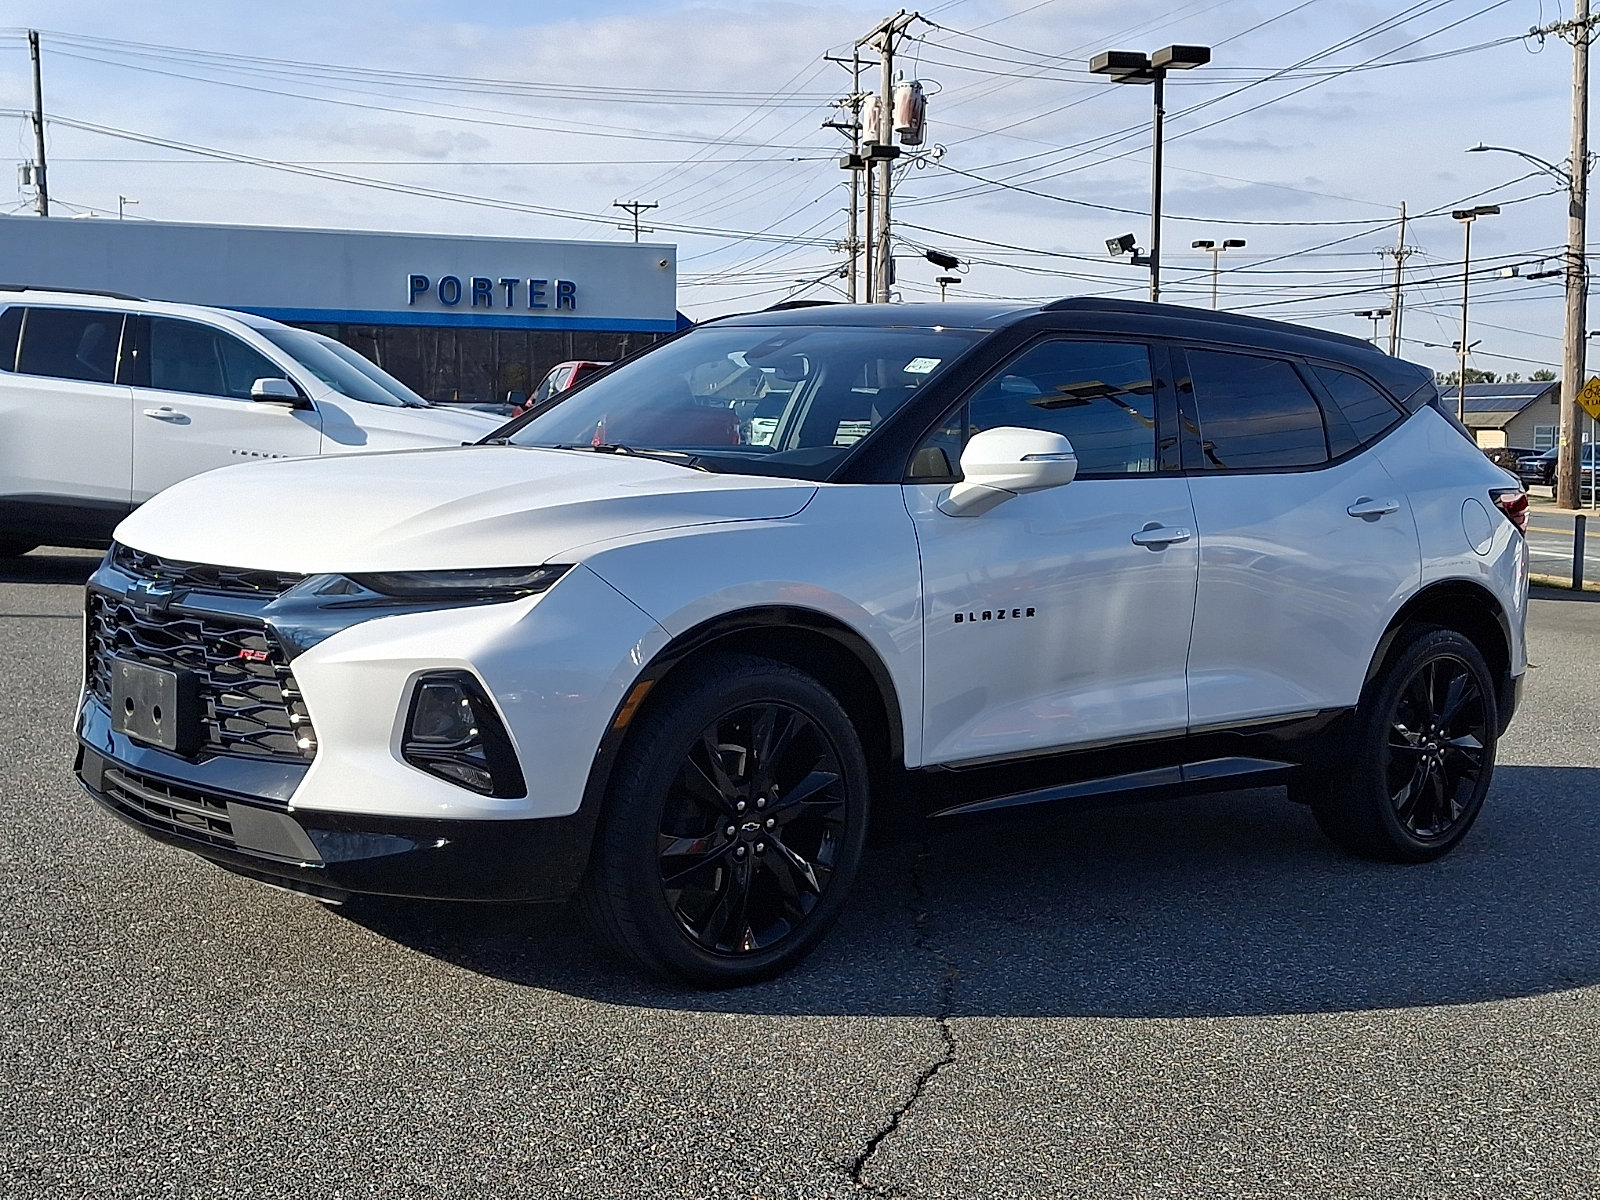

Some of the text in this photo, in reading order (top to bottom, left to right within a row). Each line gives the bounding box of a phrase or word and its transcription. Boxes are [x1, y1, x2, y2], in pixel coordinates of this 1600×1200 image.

[407, 273, 577, 310] PORTER
[954, 607, 1036, 623] BLAZER
[238, 649, 269, 661] RS
